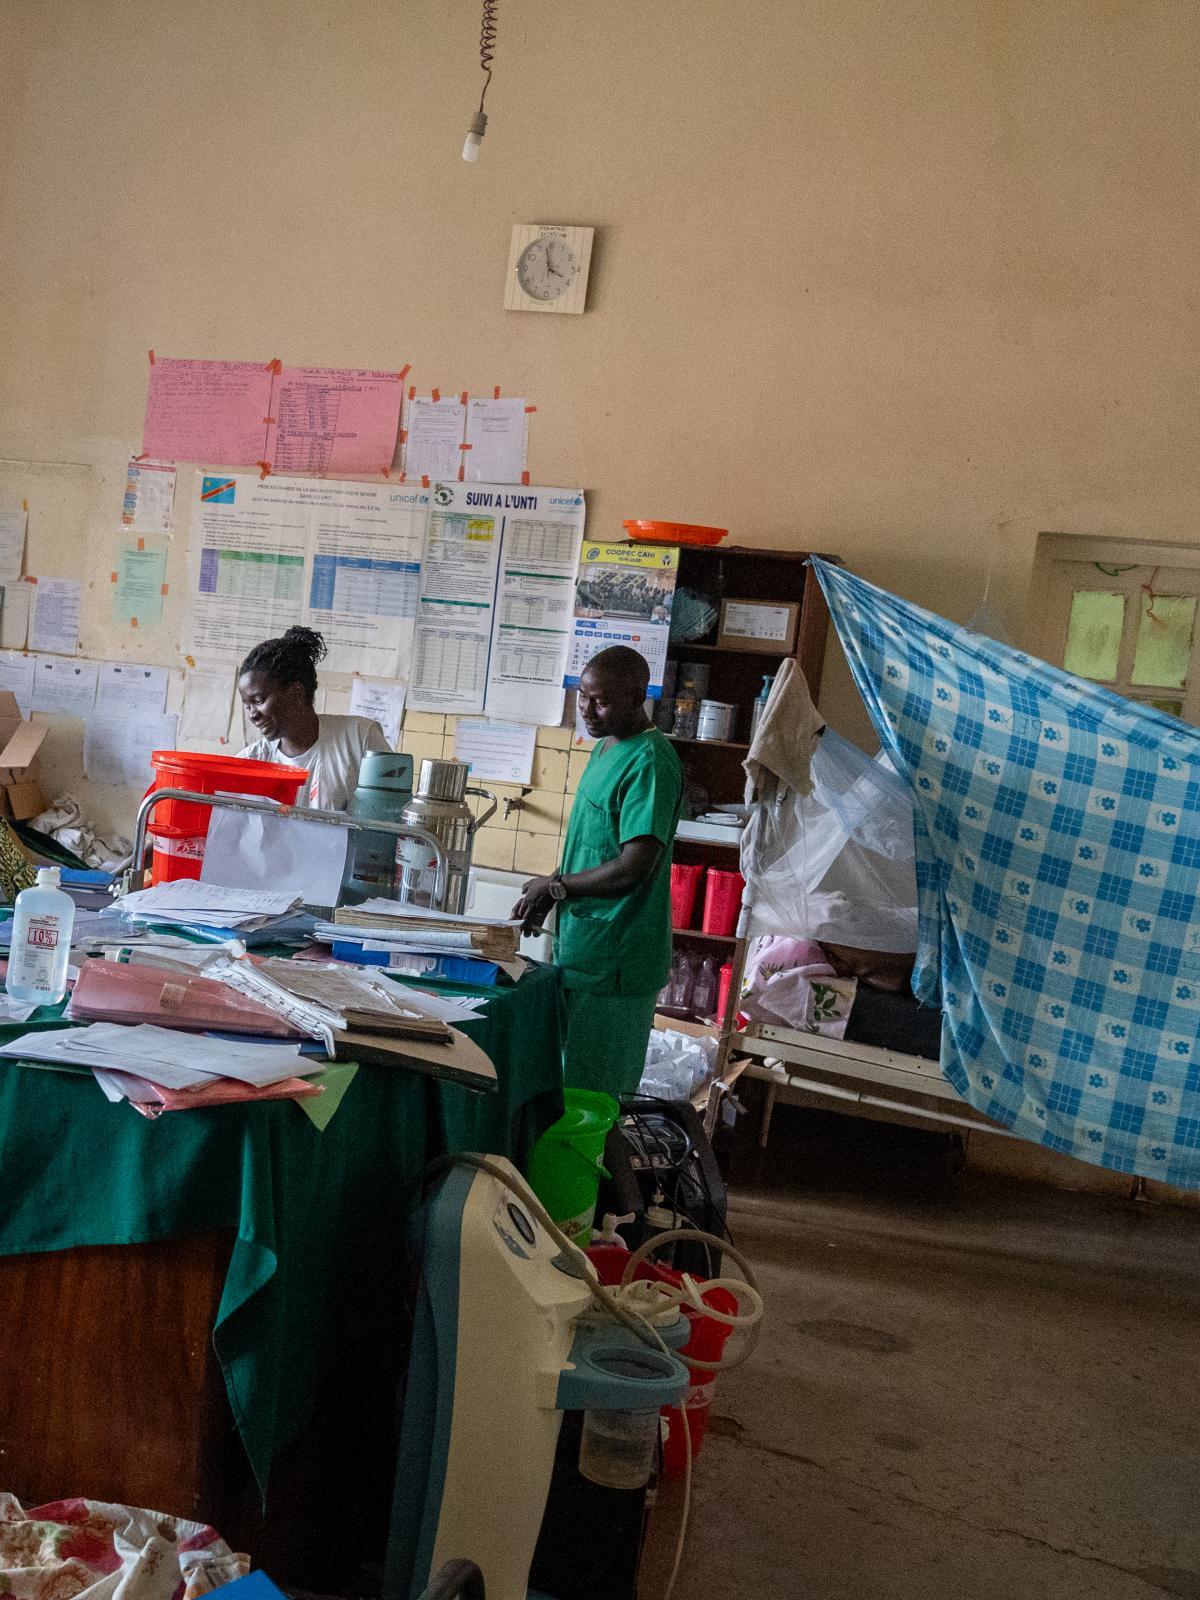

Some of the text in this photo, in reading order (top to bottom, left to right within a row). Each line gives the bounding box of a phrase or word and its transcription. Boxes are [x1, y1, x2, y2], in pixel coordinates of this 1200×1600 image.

[389, 494, 418, 504] unicef
[466, 491, 493, 507] SUIVI
[495, 494, 502, 508] A
[504, 495, 538, 511] L'UNTI
[549, 496, 574, 506] unicef
[606, 548, 636, 557] COOPEC
[33, 929, 53, 944] 10%
